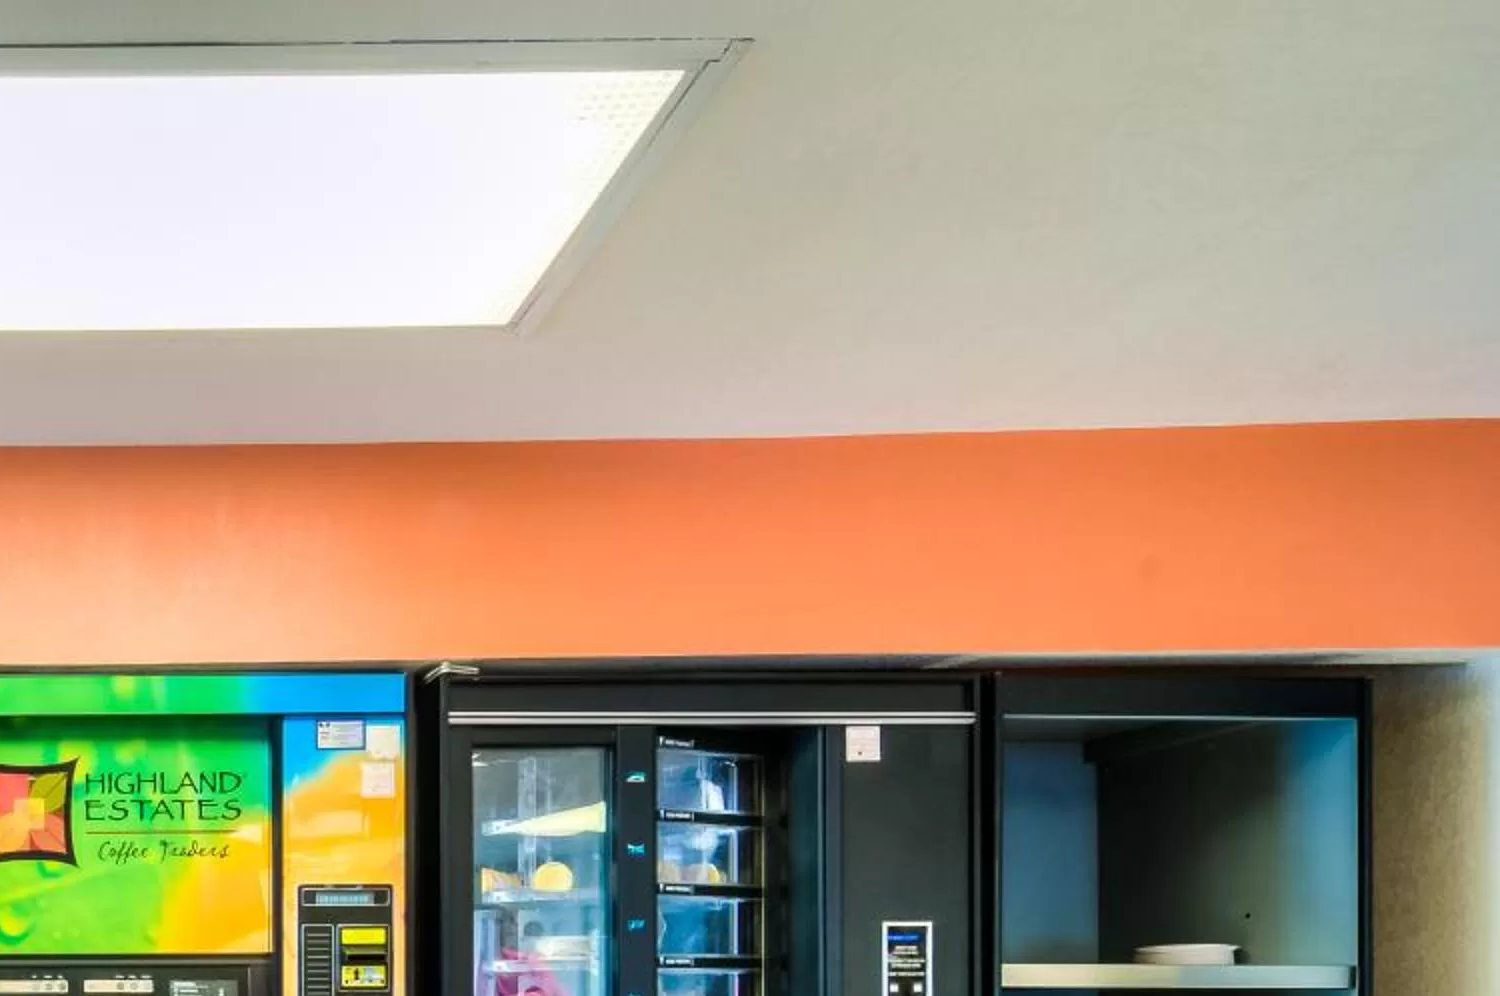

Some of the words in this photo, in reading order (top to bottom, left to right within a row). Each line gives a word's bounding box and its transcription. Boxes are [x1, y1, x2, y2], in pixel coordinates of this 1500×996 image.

[85, 772, 243, 794] HIGHLAND
[85, 799, 242, 822] ESTATES
[97, 841, 149, 865] Coffee
[158, 840, 230, 864] Traders
